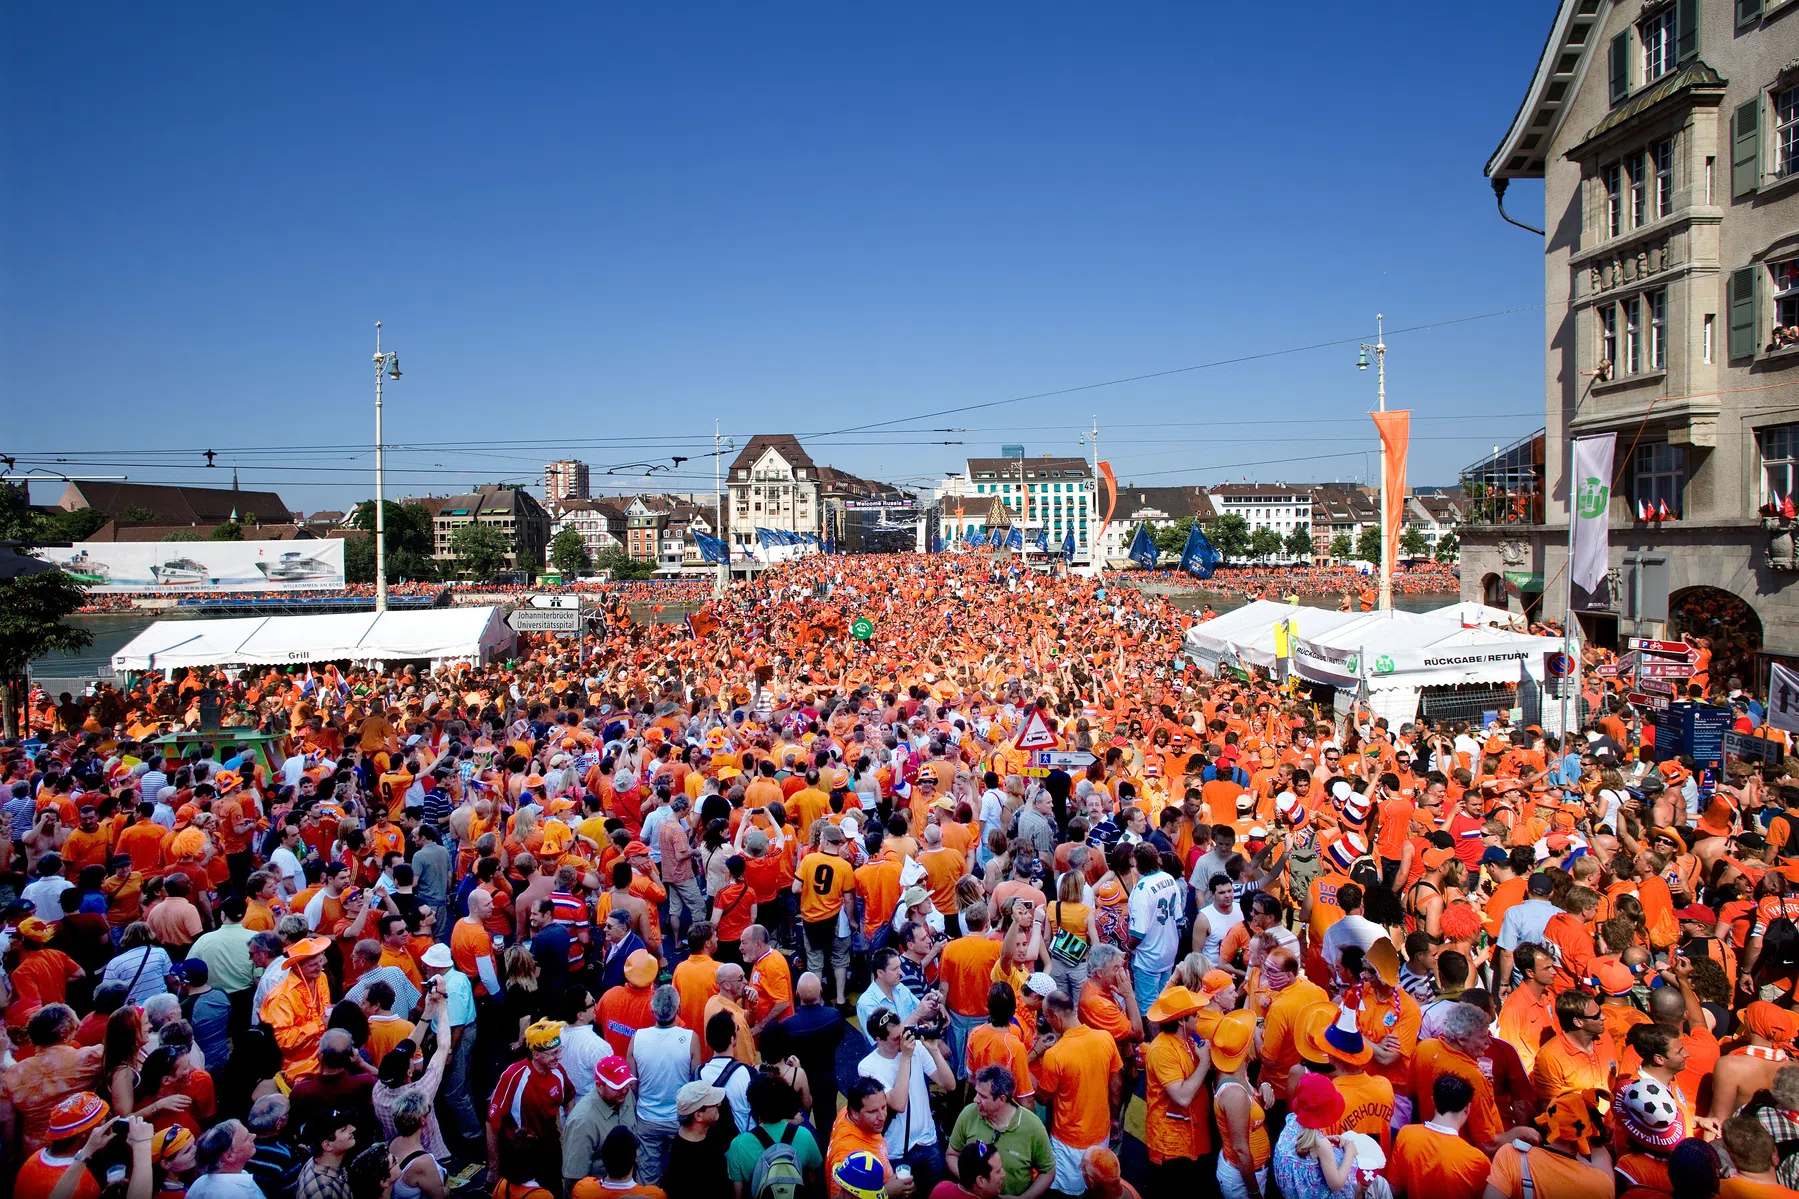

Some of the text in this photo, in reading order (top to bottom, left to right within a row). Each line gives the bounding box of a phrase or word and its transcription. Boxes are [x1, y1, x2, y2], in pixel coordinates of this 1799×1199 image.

[1084, 481, 1095, 490] 45
[518, 621, 574, 629] Universitätsspital
[1424, 655, 1482, 666] RÜCKGABE
[1488, 652, 1529, 661] RETURN
[382, 782, 393, 802] 9
[813, 864, 834, 895] 9
